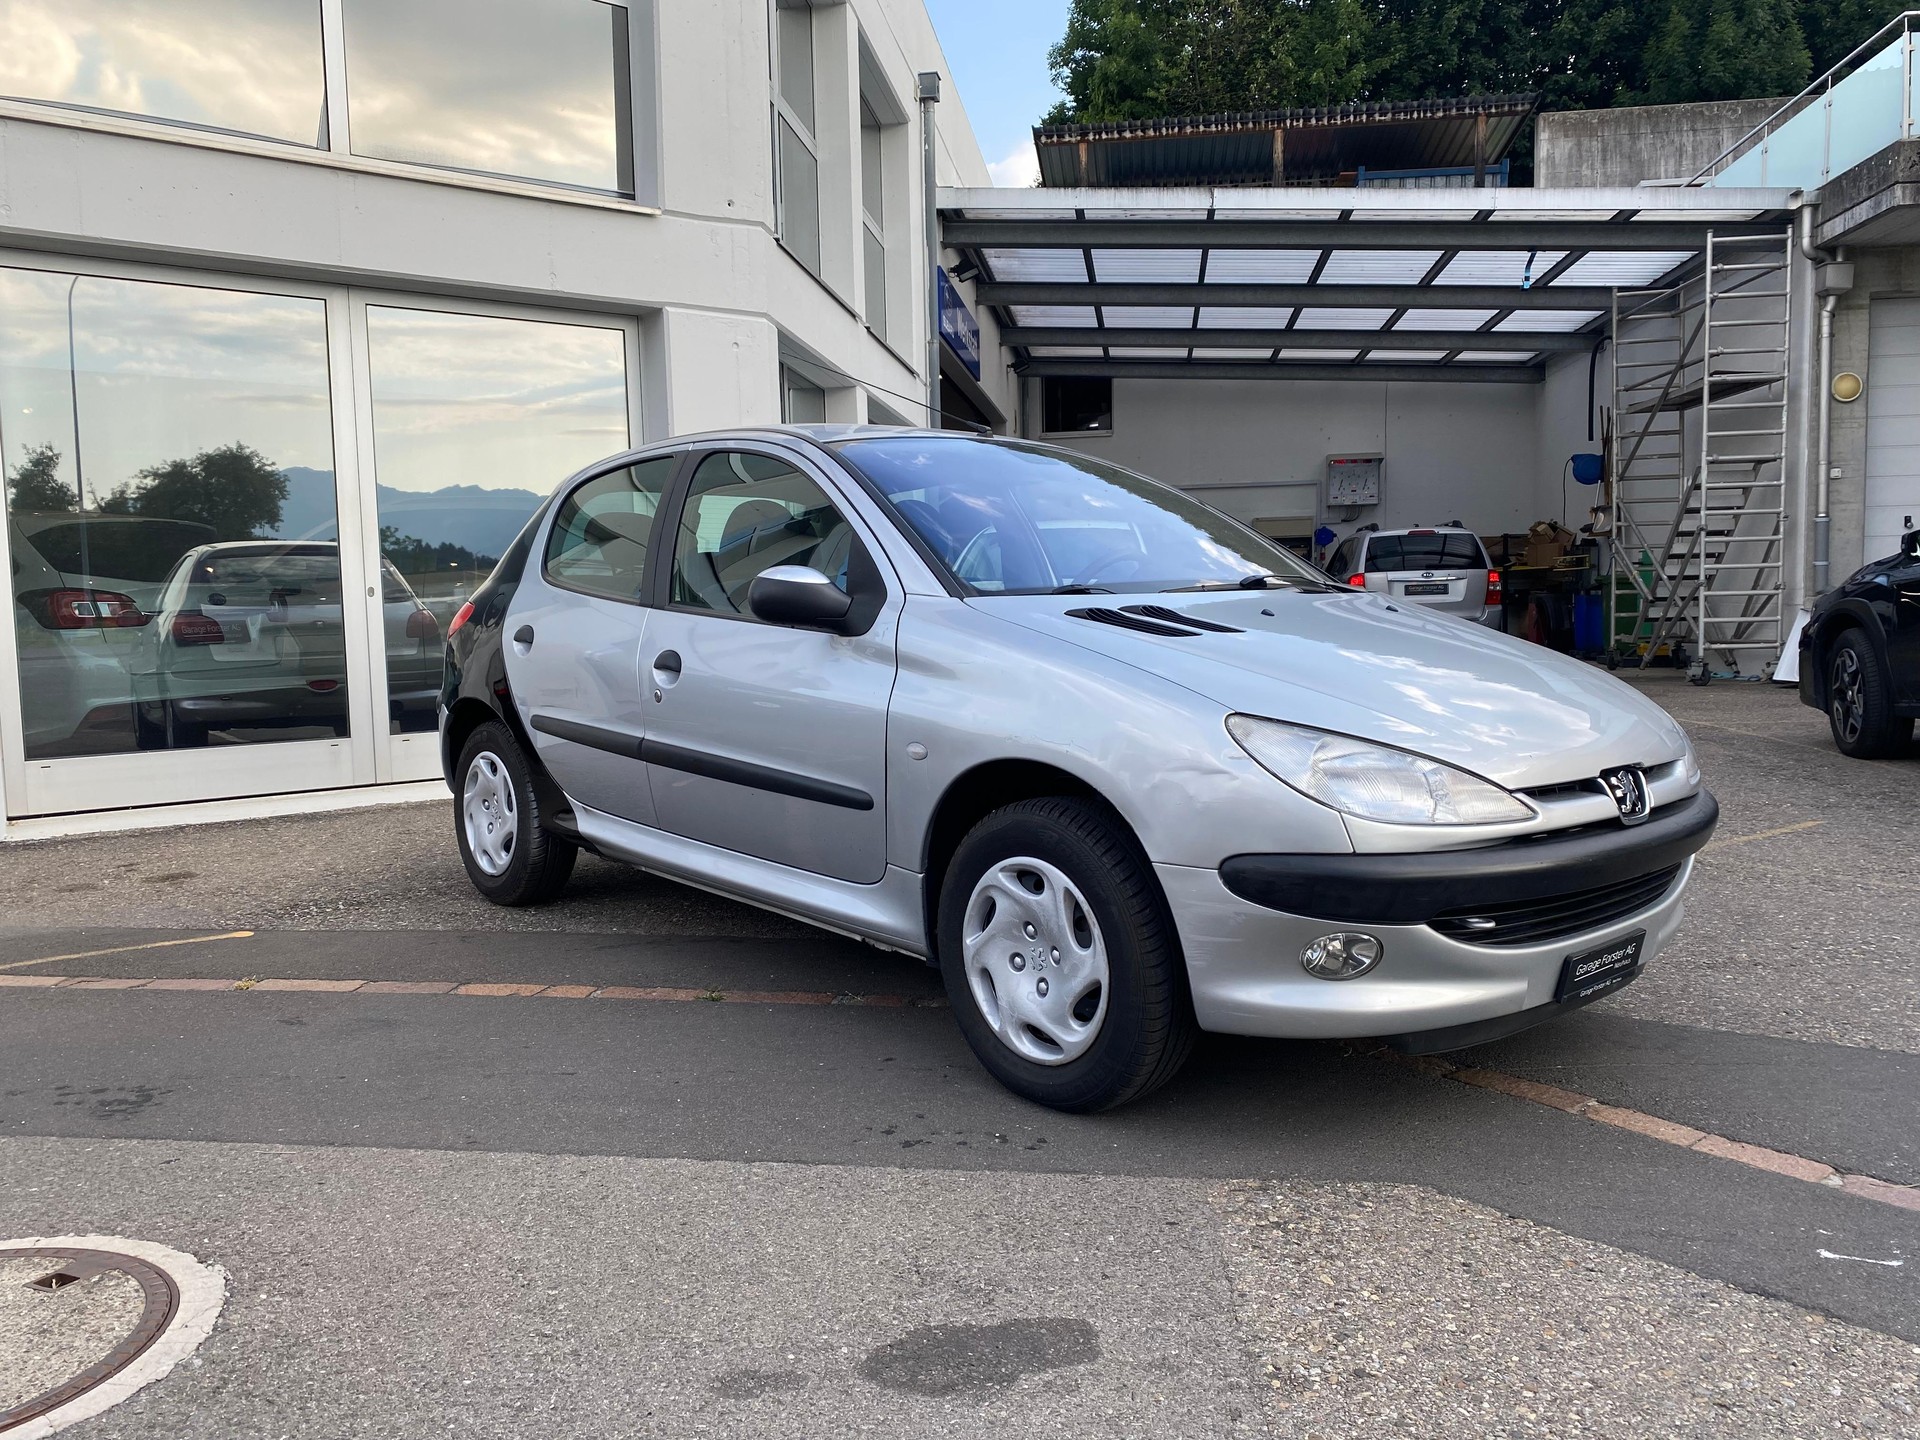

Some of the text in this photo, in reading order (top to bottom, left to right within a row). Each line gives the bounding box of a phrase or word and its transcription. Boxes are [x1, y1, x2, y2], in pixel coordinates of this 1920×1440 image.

[181, 623, 241, 634] Garage Forster AG
[1576, 943, 1637, 976] Garage Forster AG
